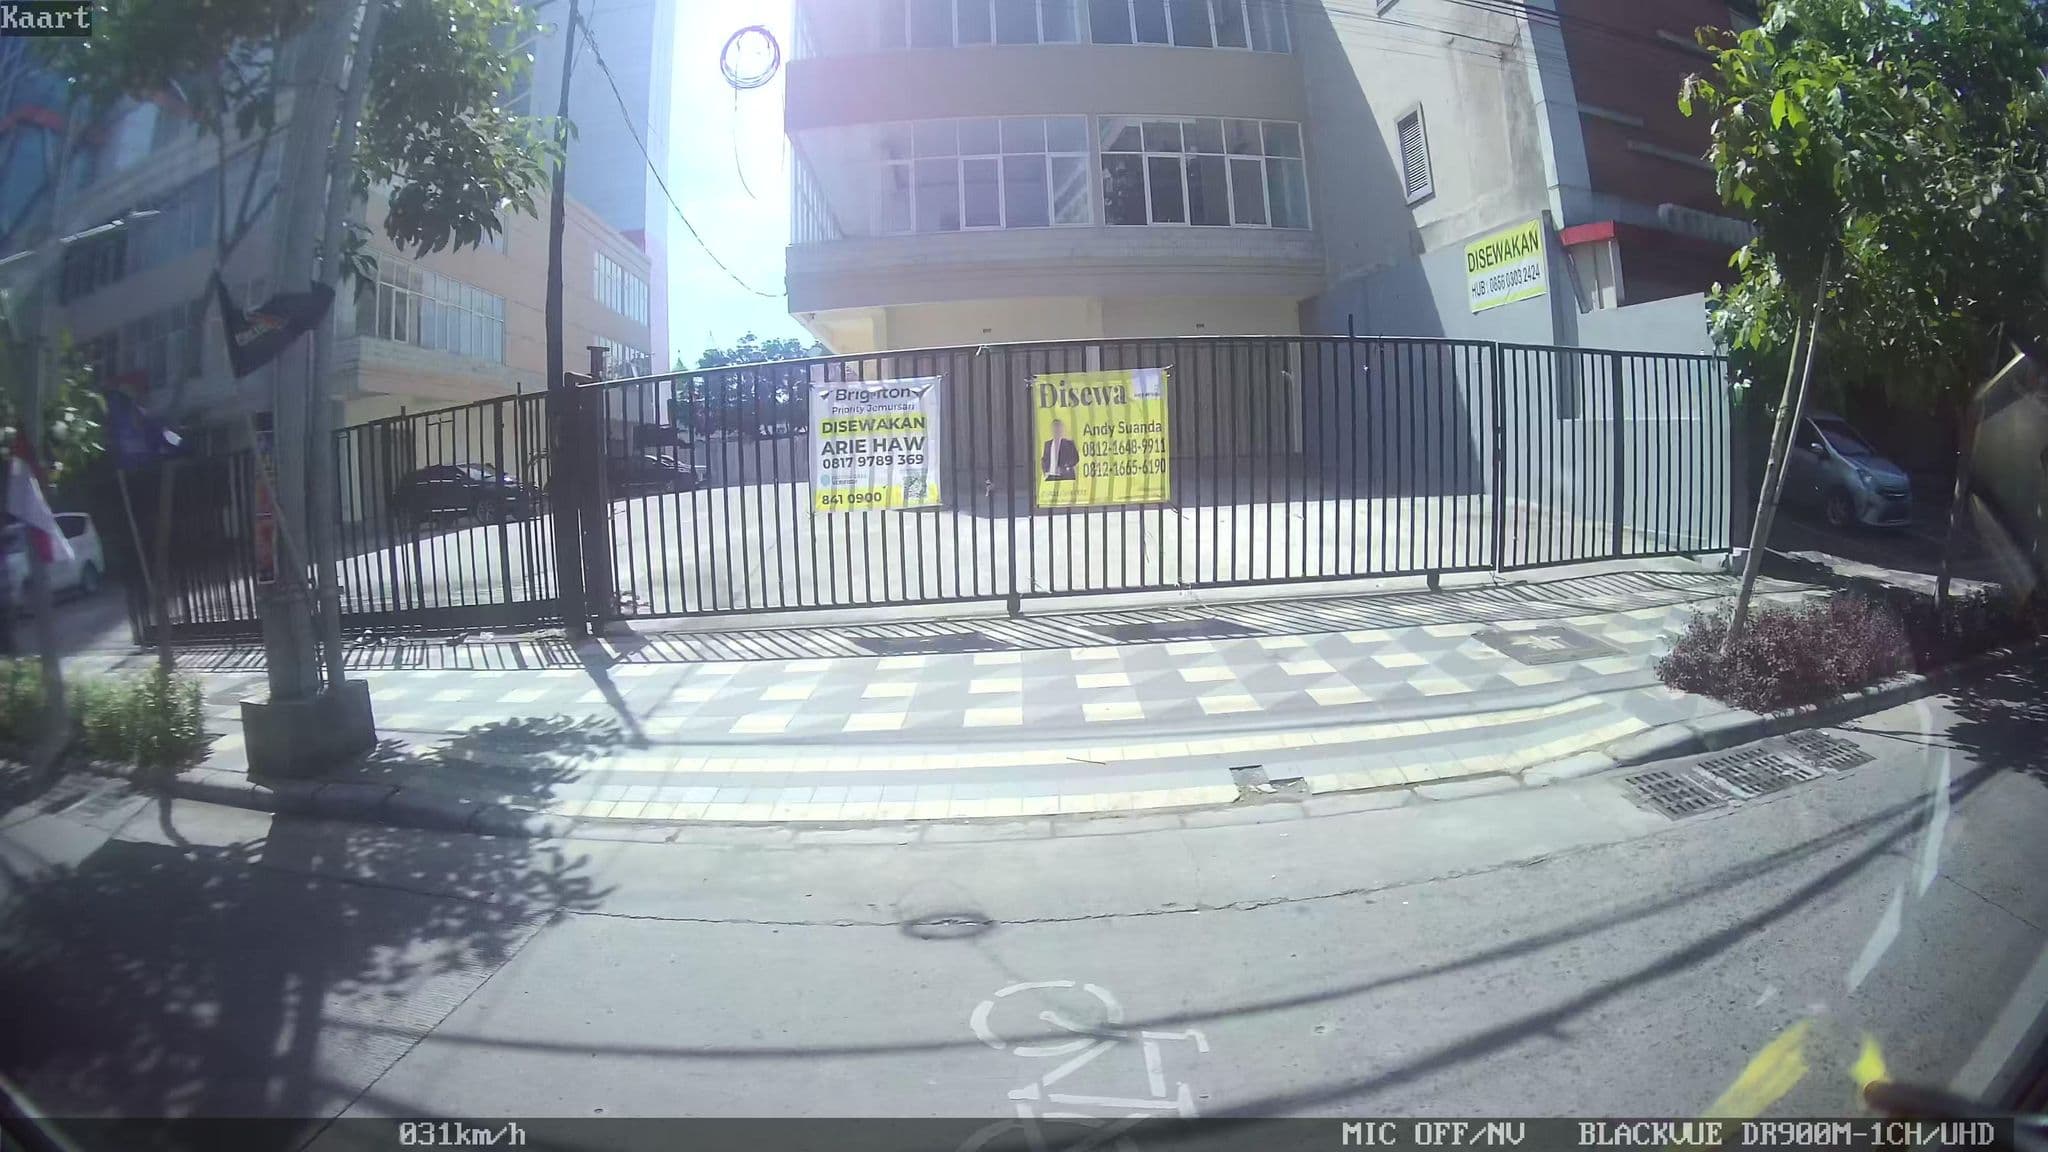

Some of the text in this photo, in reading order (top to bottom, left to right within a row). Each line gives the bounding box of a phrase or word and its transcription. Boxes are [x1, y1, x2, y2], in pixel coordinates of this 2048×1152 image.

[1467, 230, 1539, 273] DISEWAKAN
[1522, 263, 1541, 283] 2424
[1040, 380, 1127, 408] Disewa
[832, 406, 864, 415] Priority
[822, 417, 925, 433] DISEWAKAN
[1083, 420, 1162, 438] Andy Suanda
[821, 437, 925, 456] ARIE HAW
[1083, 438, 1165, 457] 0812-1648-9911
[822, 454, 924, 469] 0817 9789 369
[1083, 457, 1166, 477] 0812-1665-6190
[822, 492, 882, 505] 841 0900
